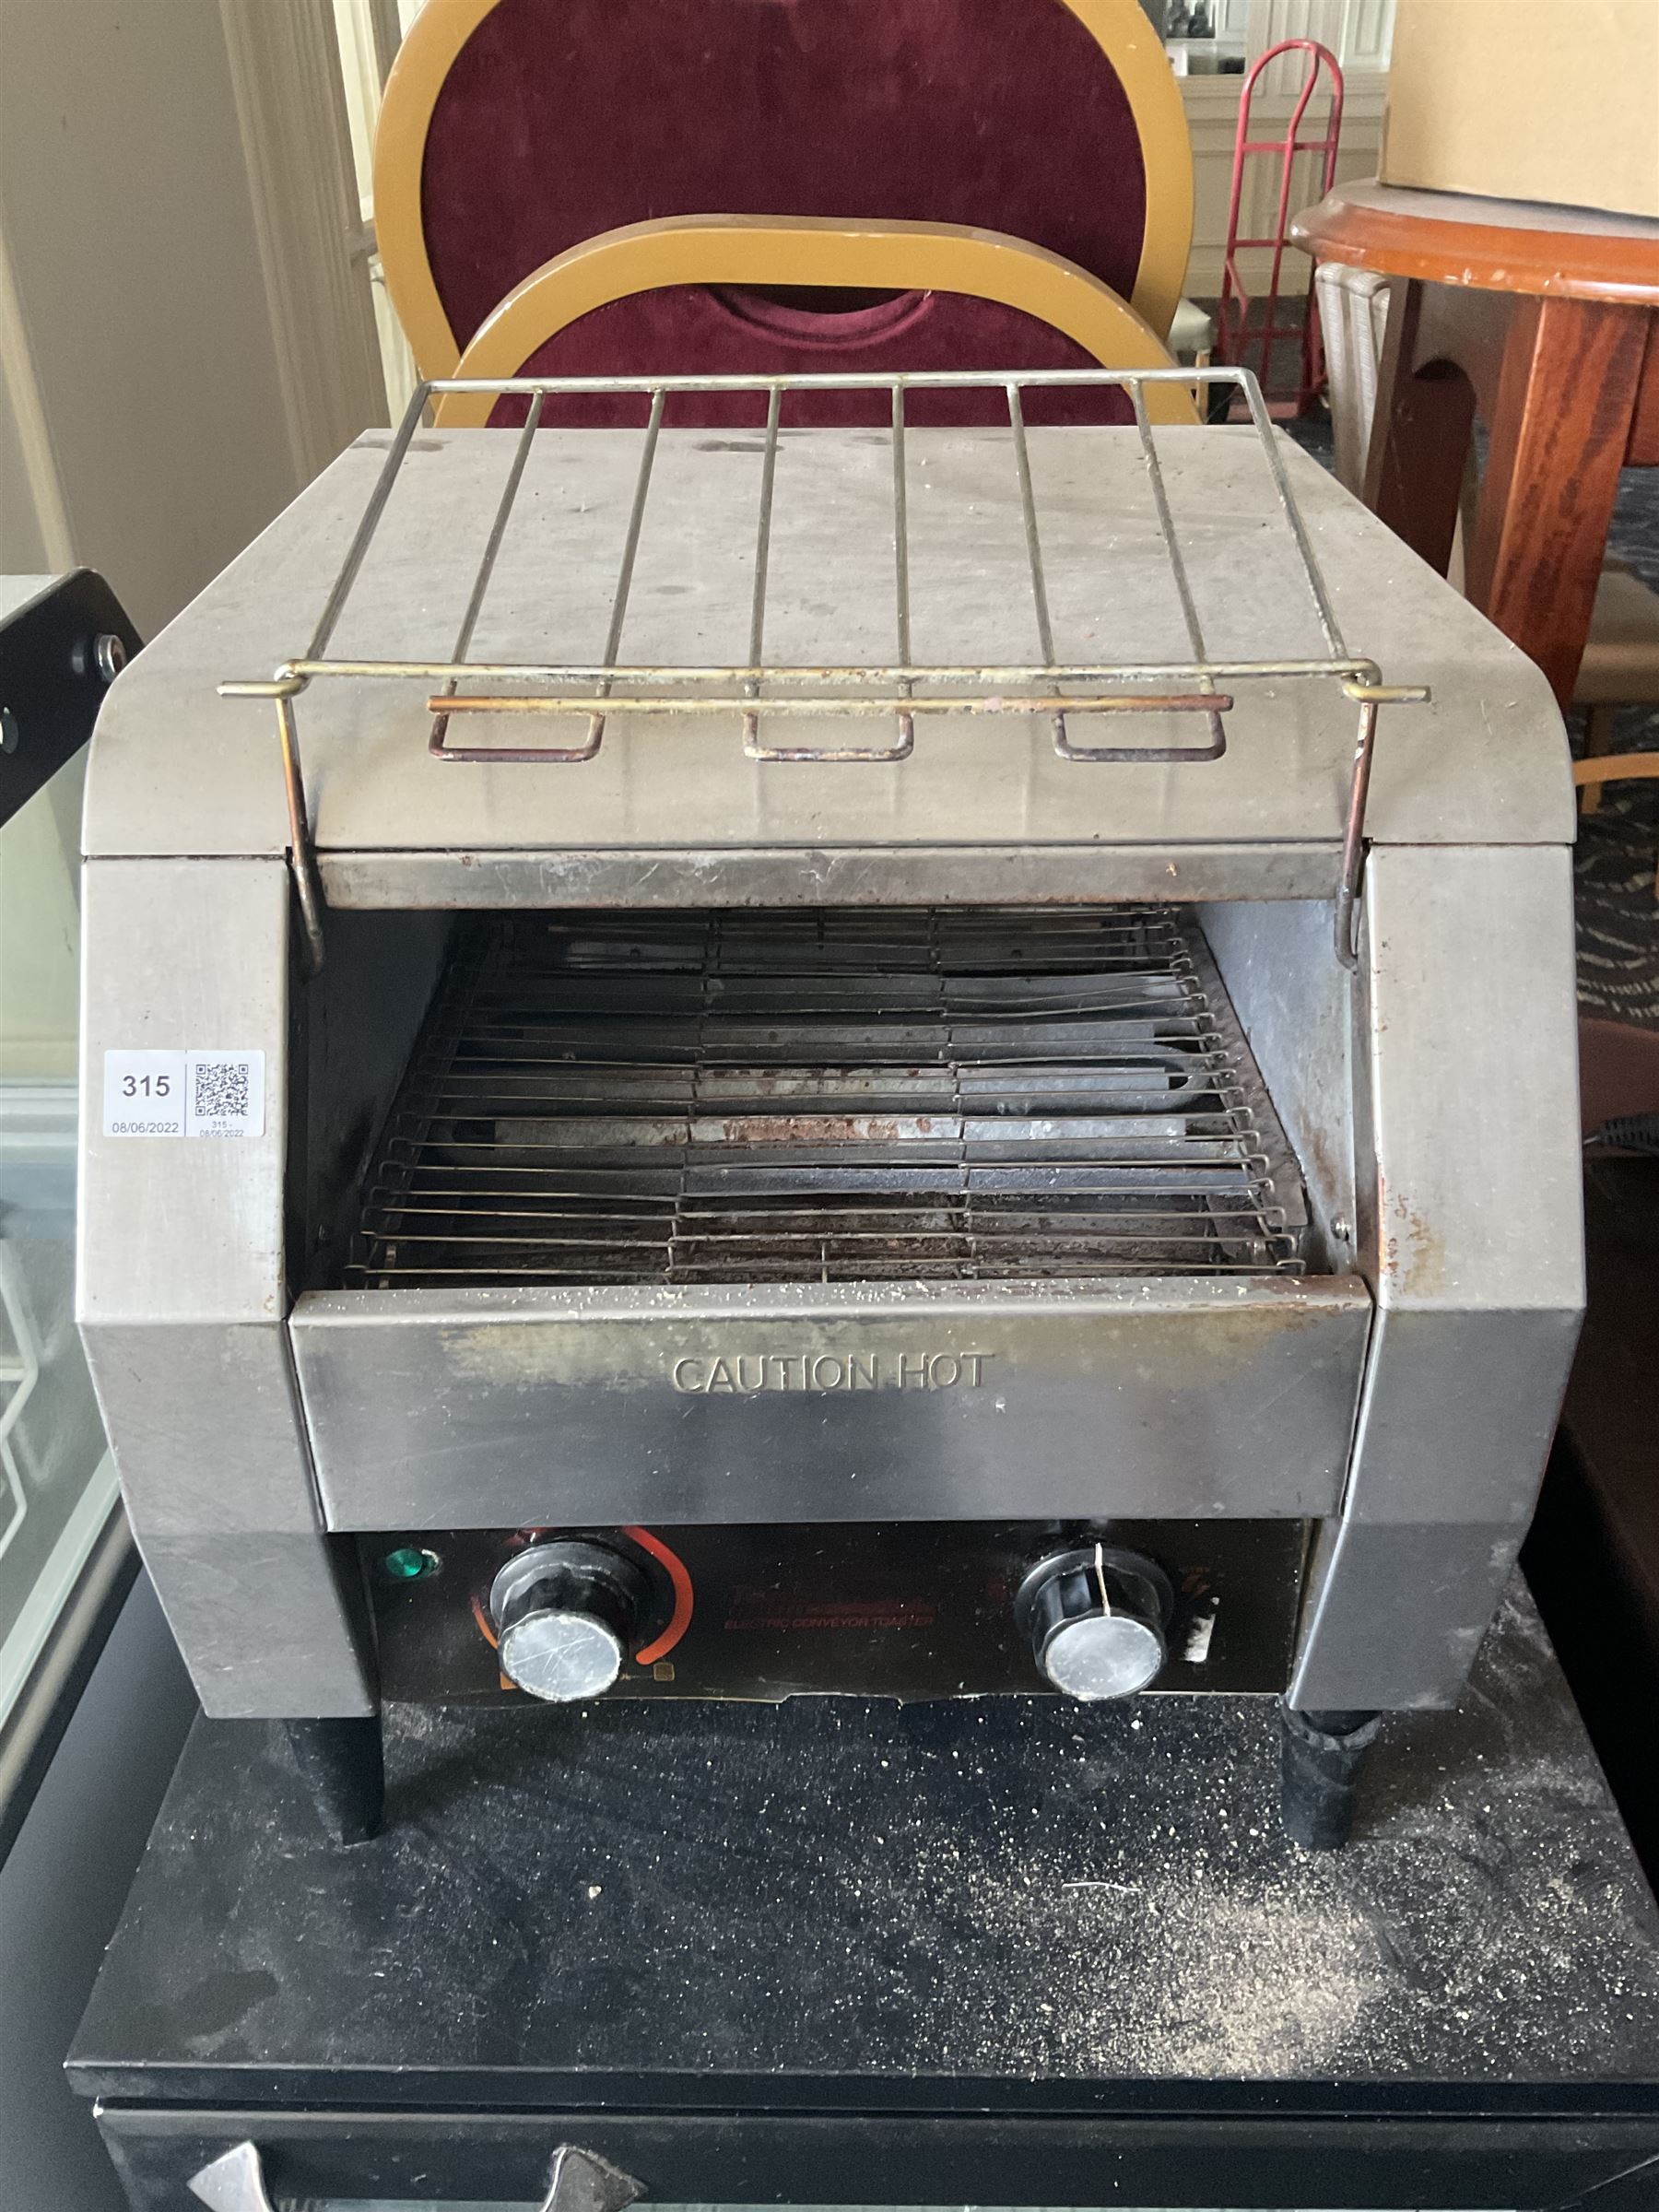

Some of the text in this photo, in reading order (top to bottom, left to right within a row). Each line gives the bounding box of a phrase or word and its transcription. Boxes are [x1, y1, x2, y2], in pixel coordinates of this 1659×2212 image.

[122, 1075, 171, 1097] 315
[112, 1122, 179, 1134] 08/06/2022
[211, 1121, 228, 1129] 315
[673, 1352, 995, 1393] CAUTION HOT
